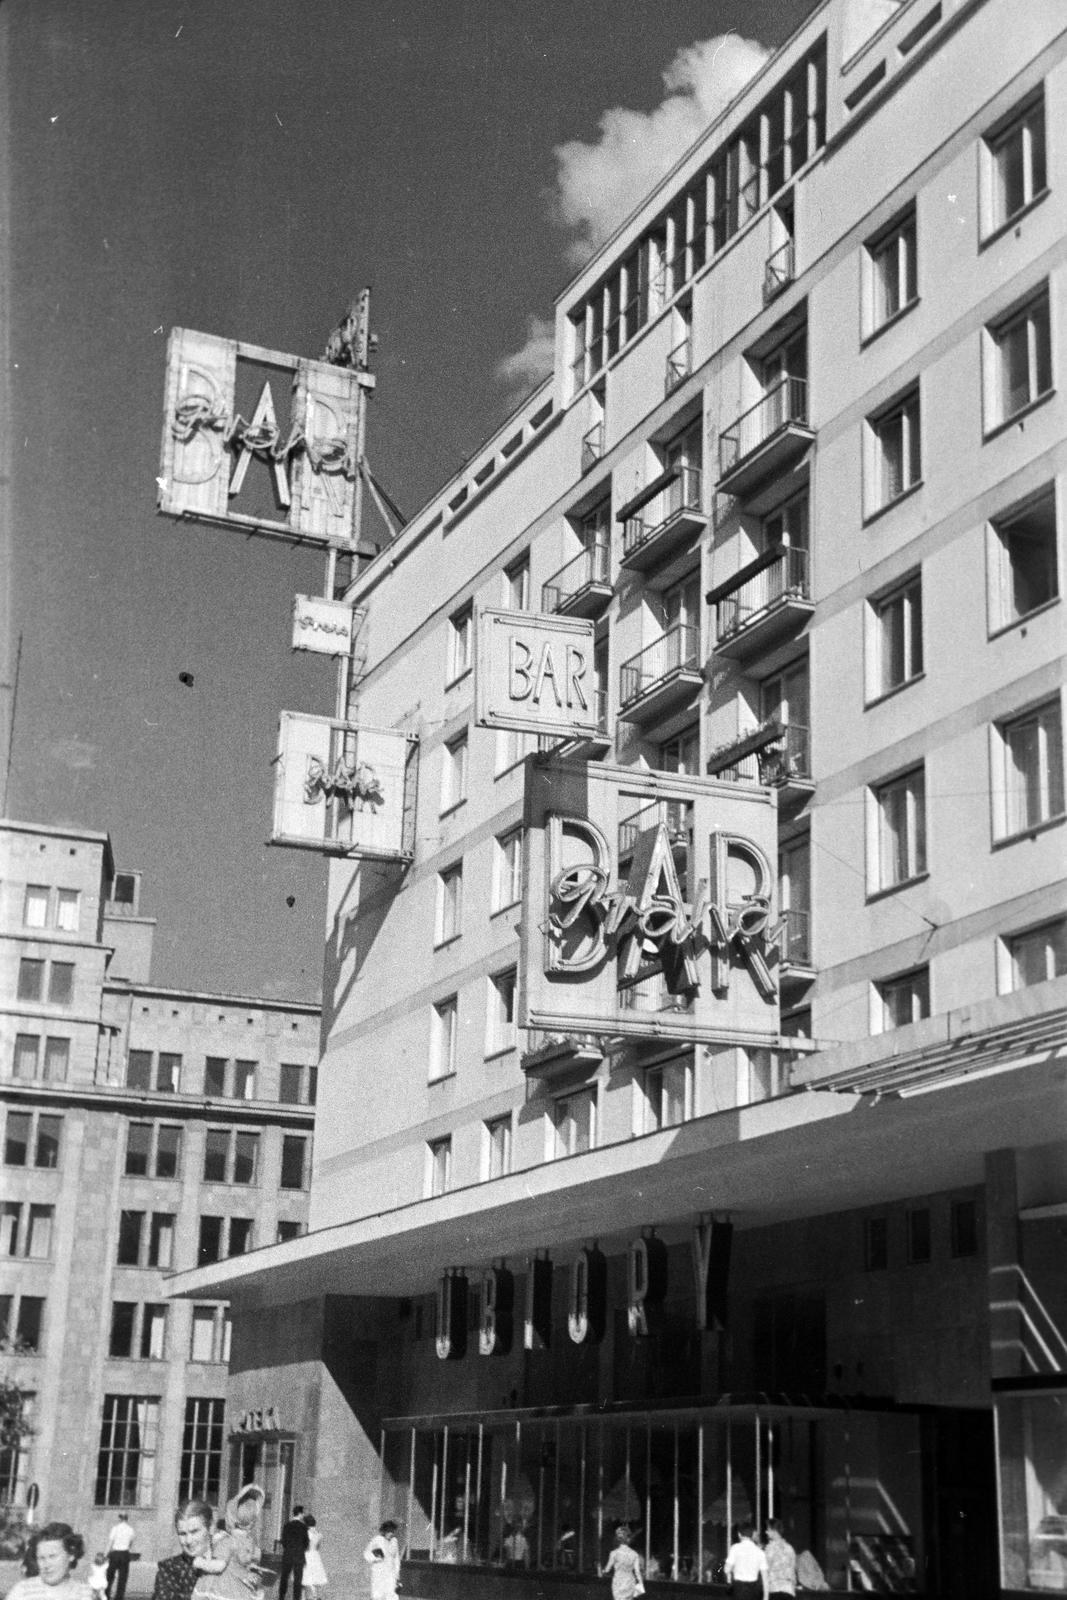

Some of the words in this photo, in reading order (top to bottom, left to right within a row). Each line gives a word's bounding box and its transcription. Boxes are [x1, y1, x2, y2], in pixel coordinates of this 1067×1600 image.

[510, 636, 587, 711] BAR
[545, 811, 777, 998] BAR
[436, 1222, 731, 1359] UBIORY
